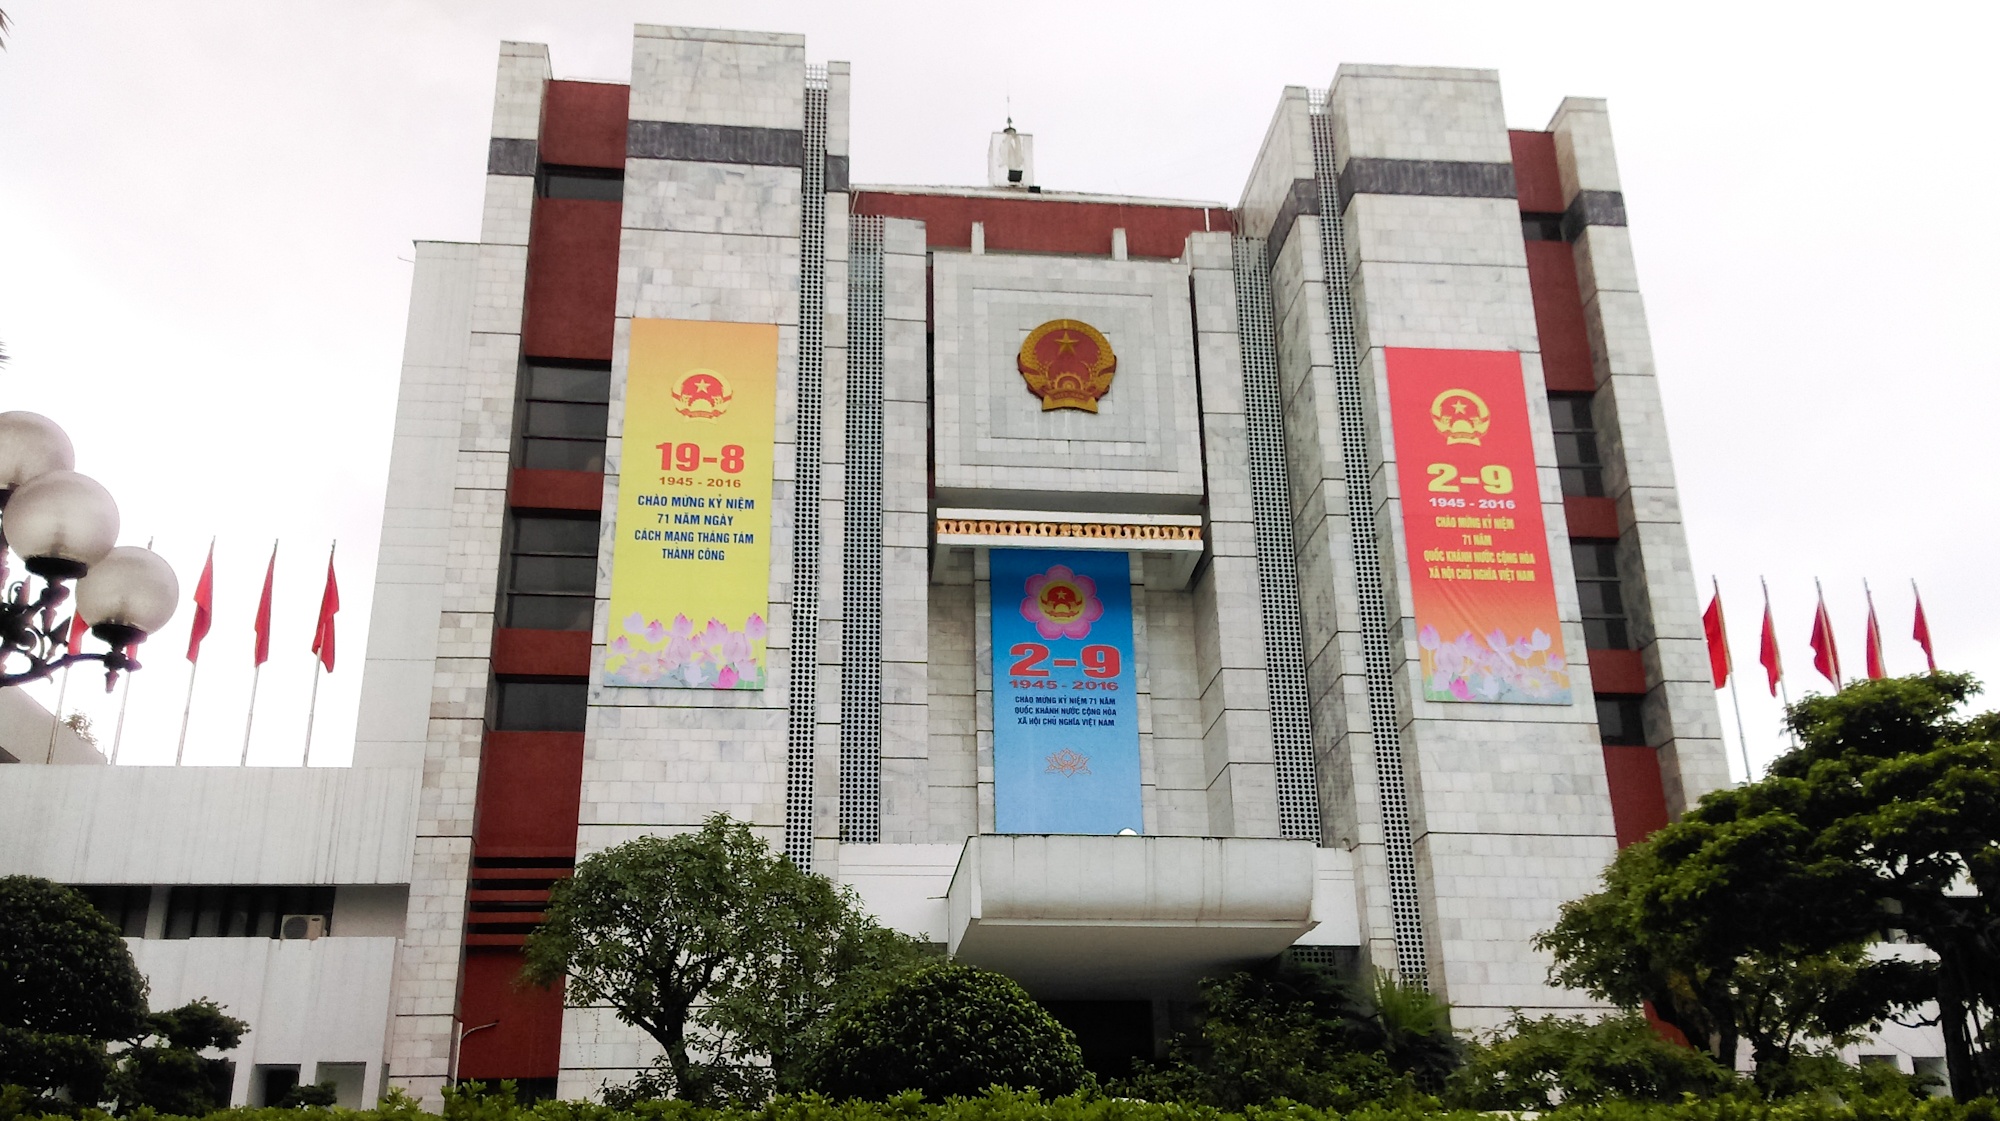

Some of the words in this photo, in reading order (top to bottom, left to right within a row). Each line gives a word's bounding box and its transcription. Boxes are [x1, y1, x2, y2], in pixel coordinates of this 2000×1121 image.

[656, 442, 744, 474] 19-8
[659, 477, 693, 486] 1945
[707, 478, 741, 488] 2016
[1427, 463, 1513, 494] 2-9
[638, 494, 668, 506] CHÀO
[671, 495, 704, 508] MỪNG
[709, 494, 722, 508] KỶ
[726, 497, 755, 512] NIỆM
[1429, 497, 1466, 508] 1945
[1478, 499, 1516, 509] 2016
[657, 513, 669, 524] 71
[674, 512, 700, 524] NĂM
[704, 513, 733, 526] NGÀY
[635, 528, 661, 541] CÁCH
[664, 531, 694, 544] MẠNG
[698, 530, 730, 543] THÁNG
[733, 531, 754, 544] TÁM
[662, 546, 694, 559] THÀNH
[698, 548, 725, 560] CÔNG
[1009, 642, 1121, 678] 2-9
[1009, 680, 1058, 689] 1945
[1072, 681, 1119, 691] 2016
